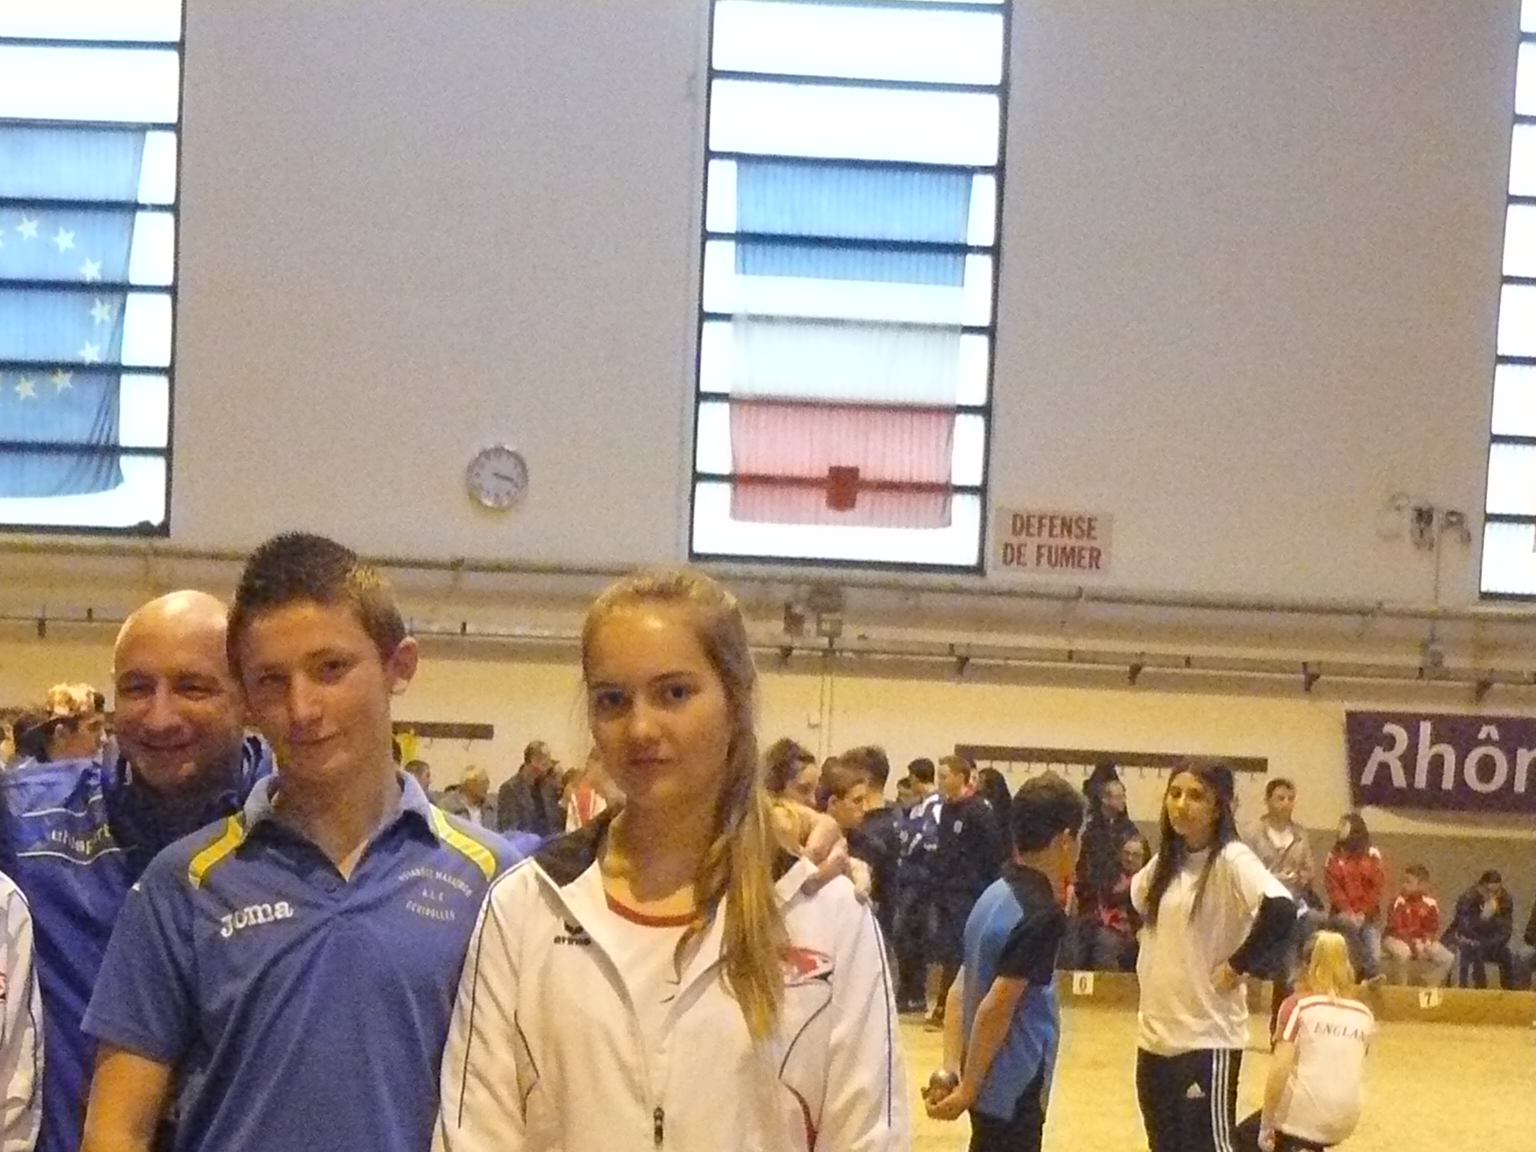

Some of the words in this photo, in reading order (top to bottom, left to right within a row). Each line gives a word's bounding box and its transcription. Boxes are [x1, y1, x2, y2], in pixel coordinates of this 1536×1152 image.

[1011, 513, 1098, 540] DEFENSE
[1002, 541, 1028, 567] DE
[1035, 543, 1102, 570] FUMER
